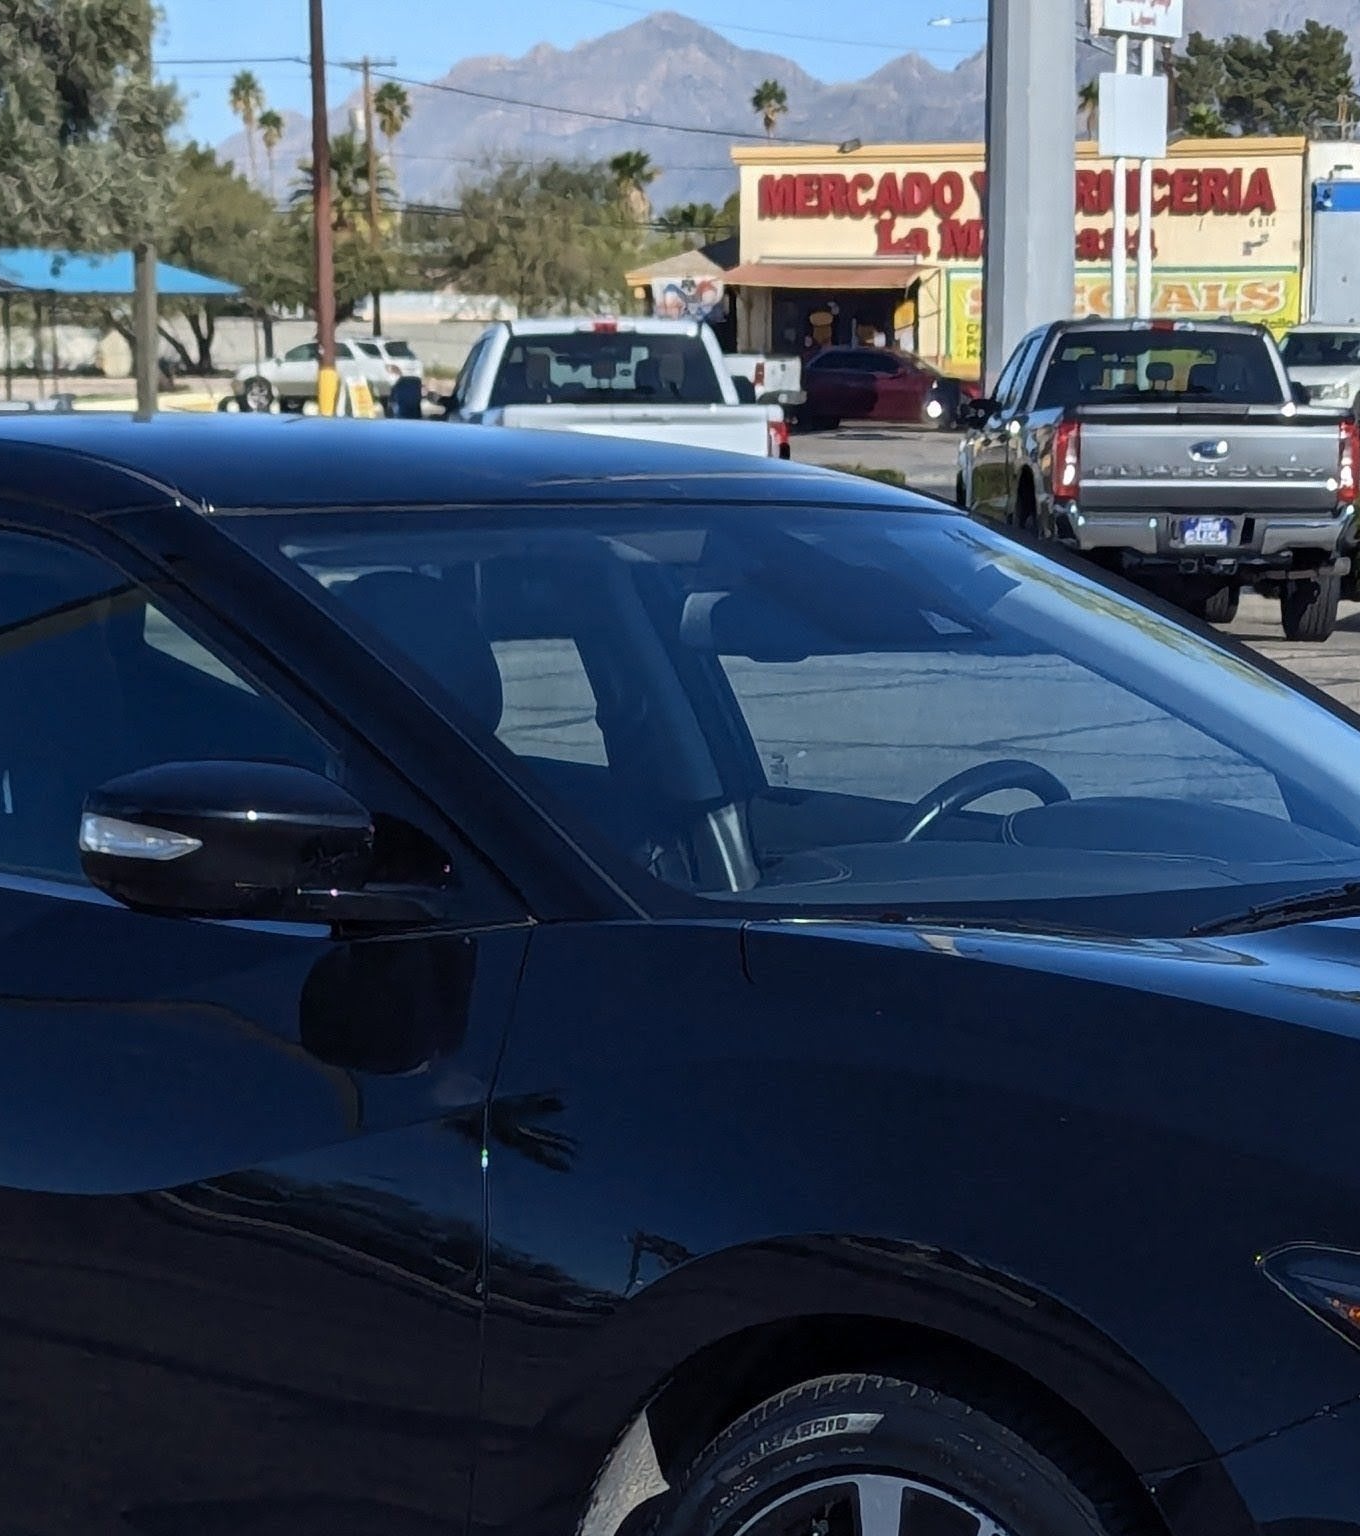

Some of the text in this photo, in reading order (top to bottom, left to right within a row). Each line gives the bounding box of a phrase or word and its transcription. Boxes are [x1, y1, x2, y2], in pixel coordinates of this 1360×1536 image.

[758, 171, 965, 221] MERCADO
[1074, 167, 1277, 217] RNICERIA
[875, 219, 931, 258] La
